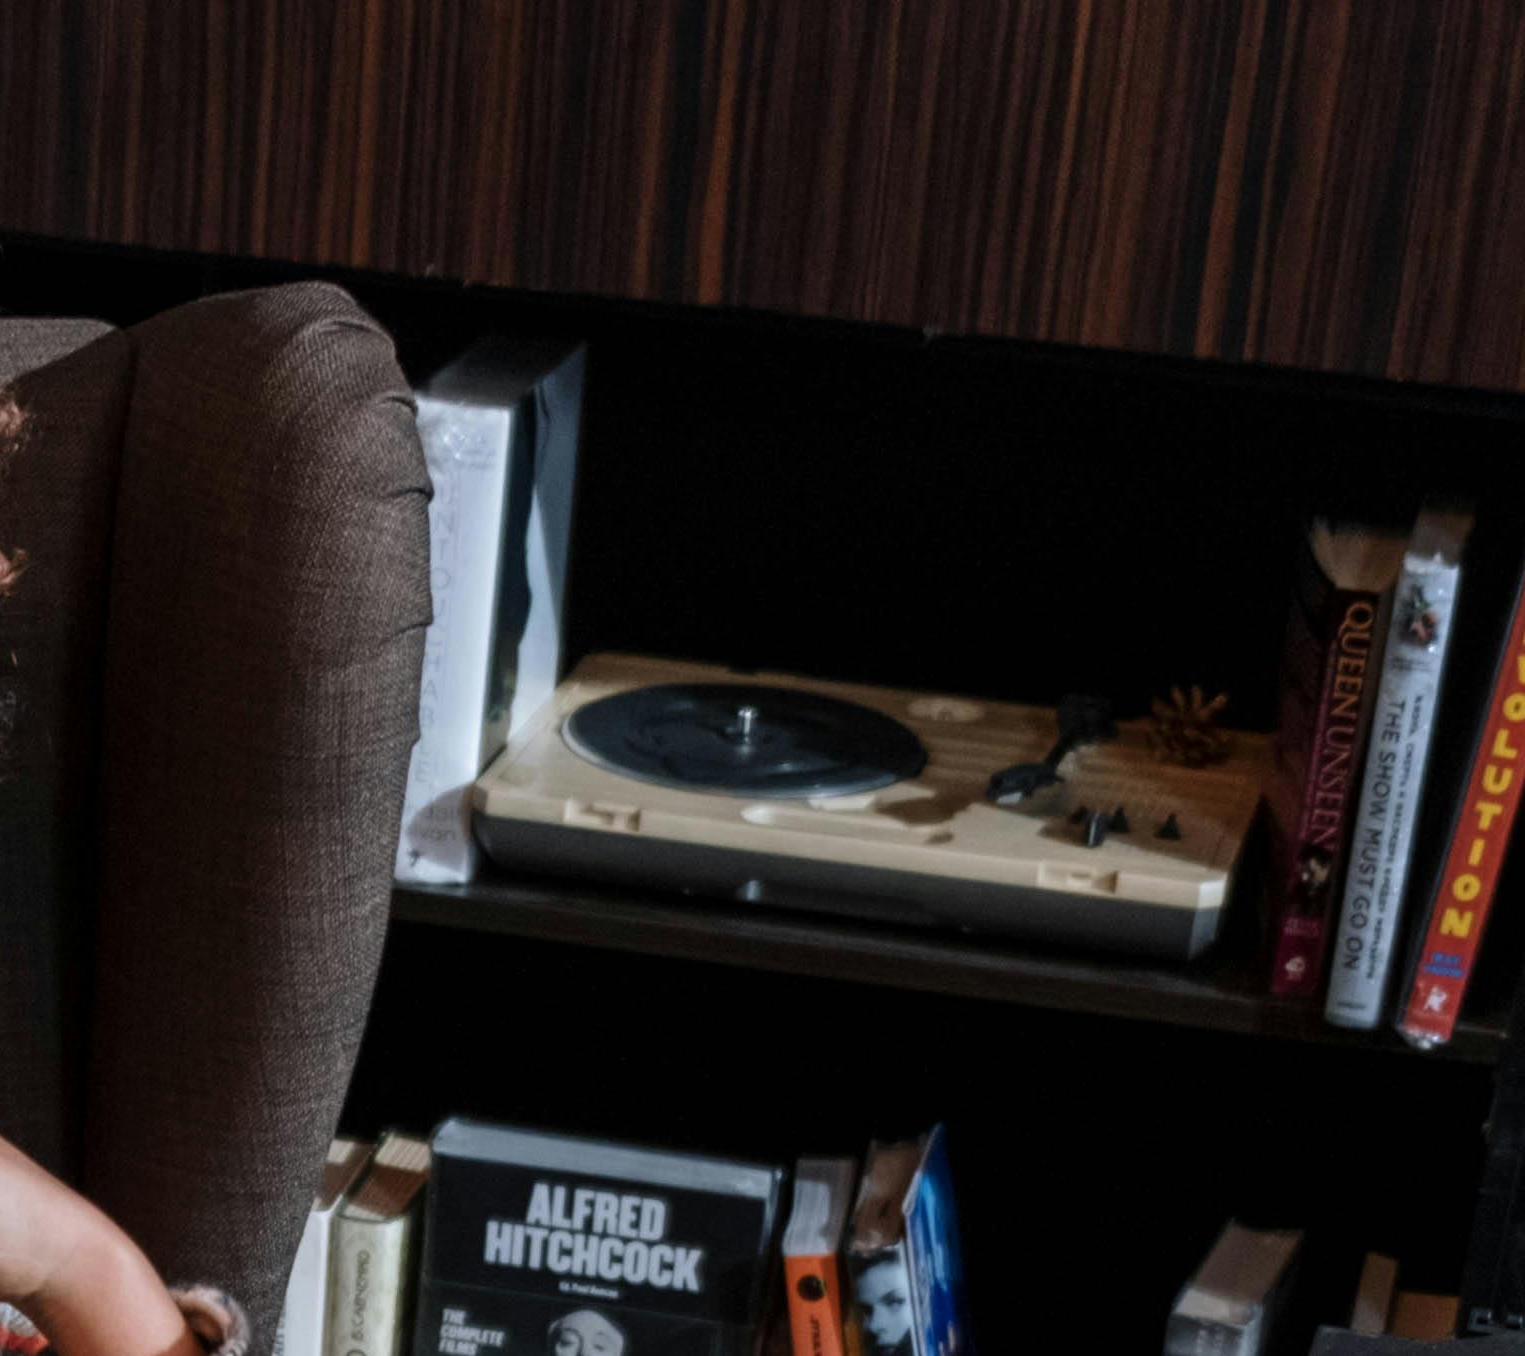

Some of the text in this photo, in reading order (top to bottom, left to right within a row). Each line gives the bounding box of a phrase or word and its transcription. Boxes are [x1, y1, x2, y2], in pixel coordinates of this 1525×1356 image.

[1309, 600, 1375, 856] QUEEN UNSEEN
[1342, 700, 1405, 970] THE SHOW MUST GO ON
[525, 1182, 666, 1242] ALFRED
[484, 1221, 703, 1291] HITCHCOCK
[439, 1324, 505, 1347] COMPLETE
[442, 1308, 467, 1325] THE
